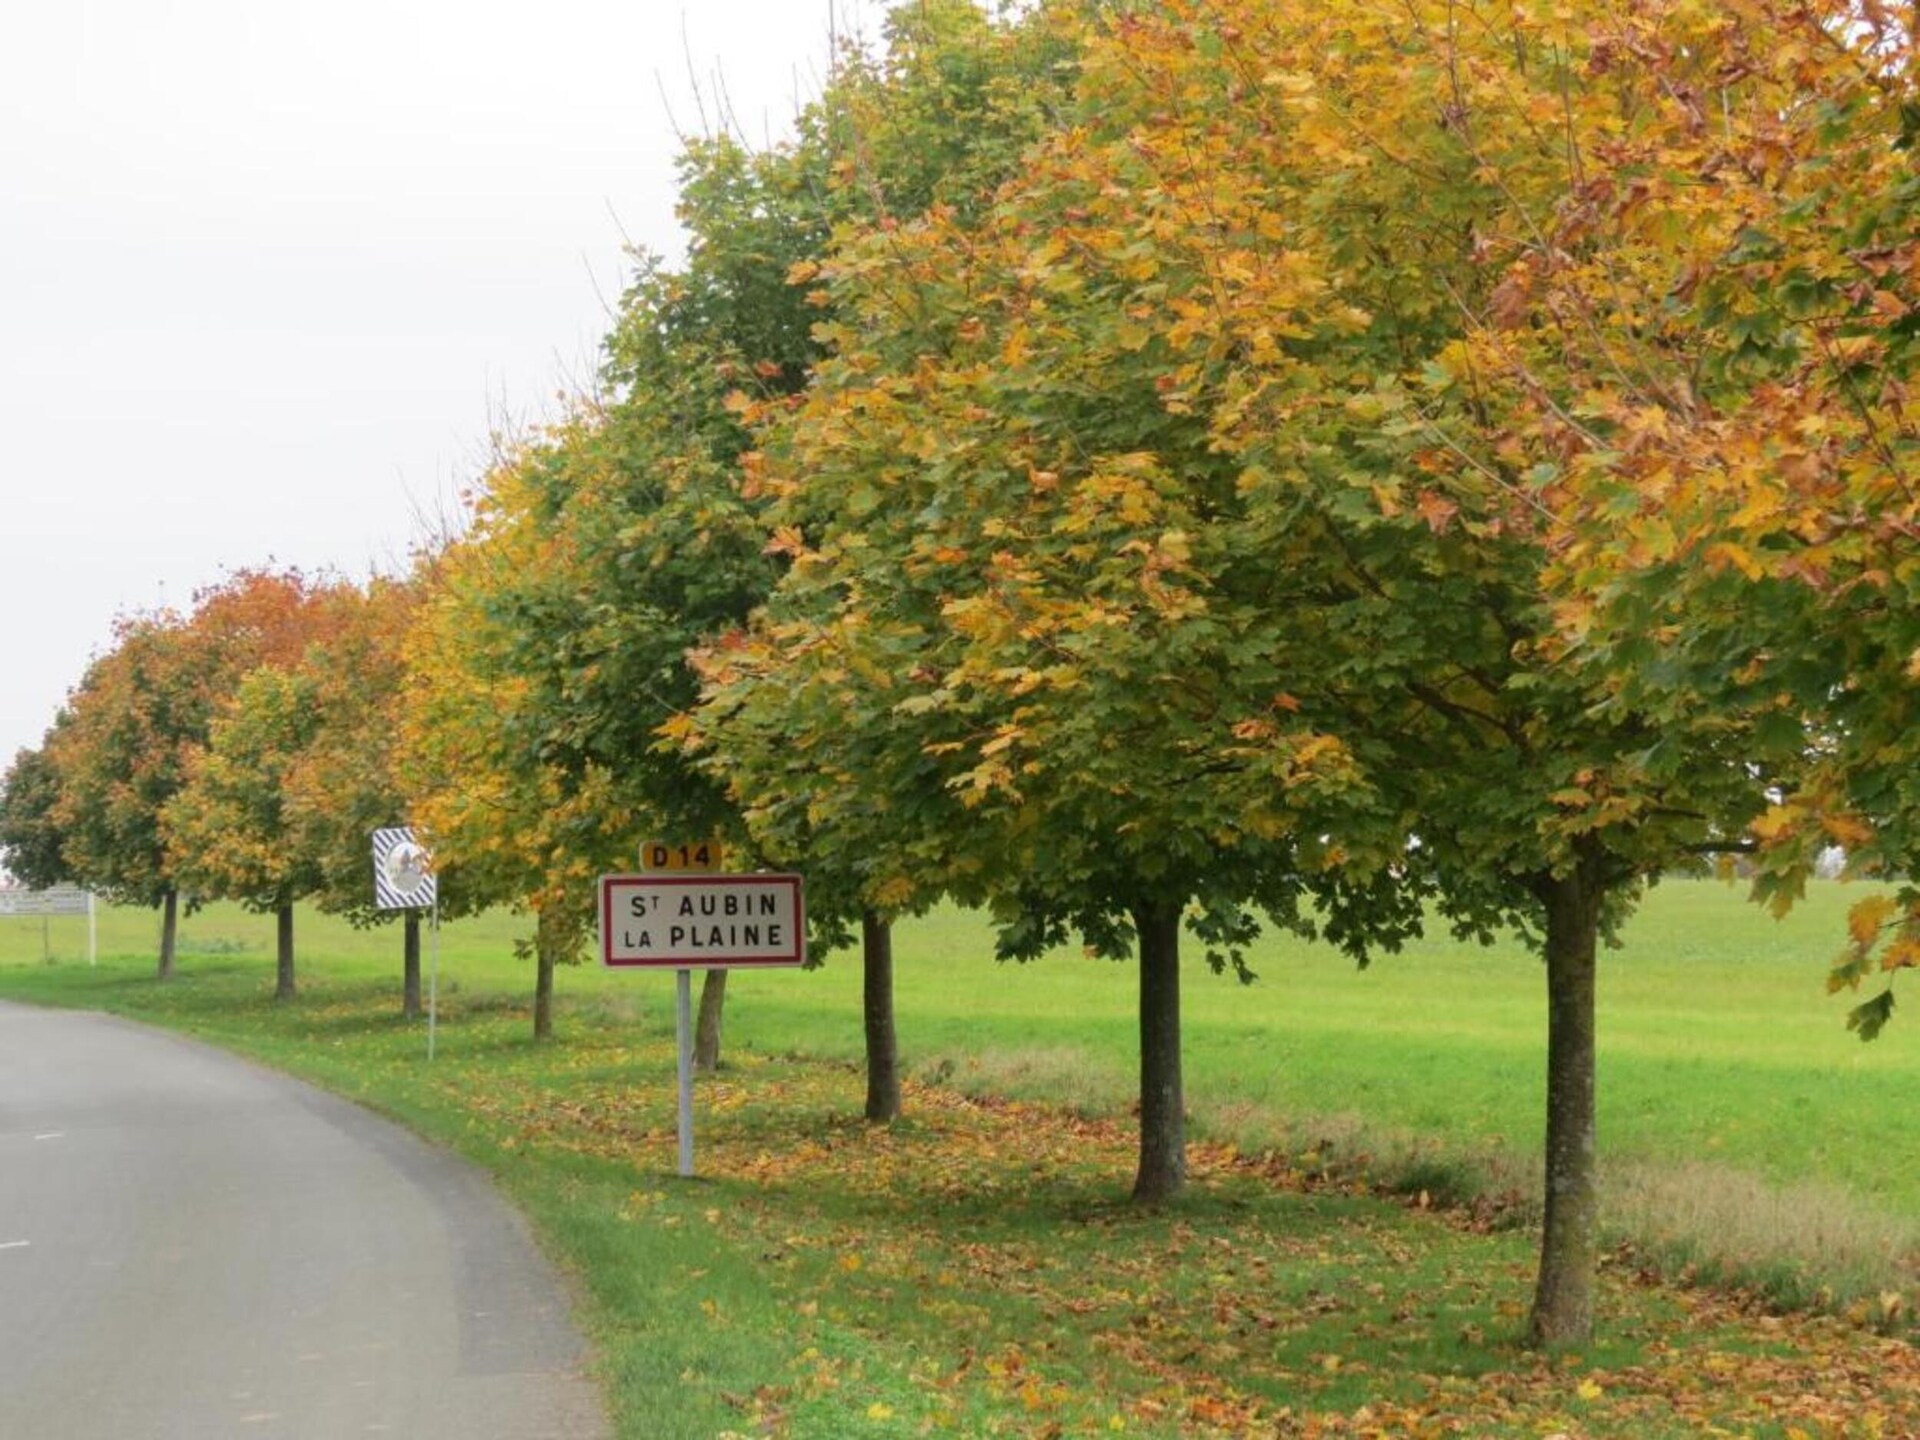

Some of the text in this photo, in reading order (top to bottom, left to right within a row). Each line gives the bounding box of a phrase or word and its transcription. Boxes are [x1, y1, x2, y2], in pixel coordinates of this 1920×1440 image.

[653, 845, 710, 867] D 14
[679, 894, 776, 916] AUBIN
[625, 925, 782, 948] LA PLAINE
